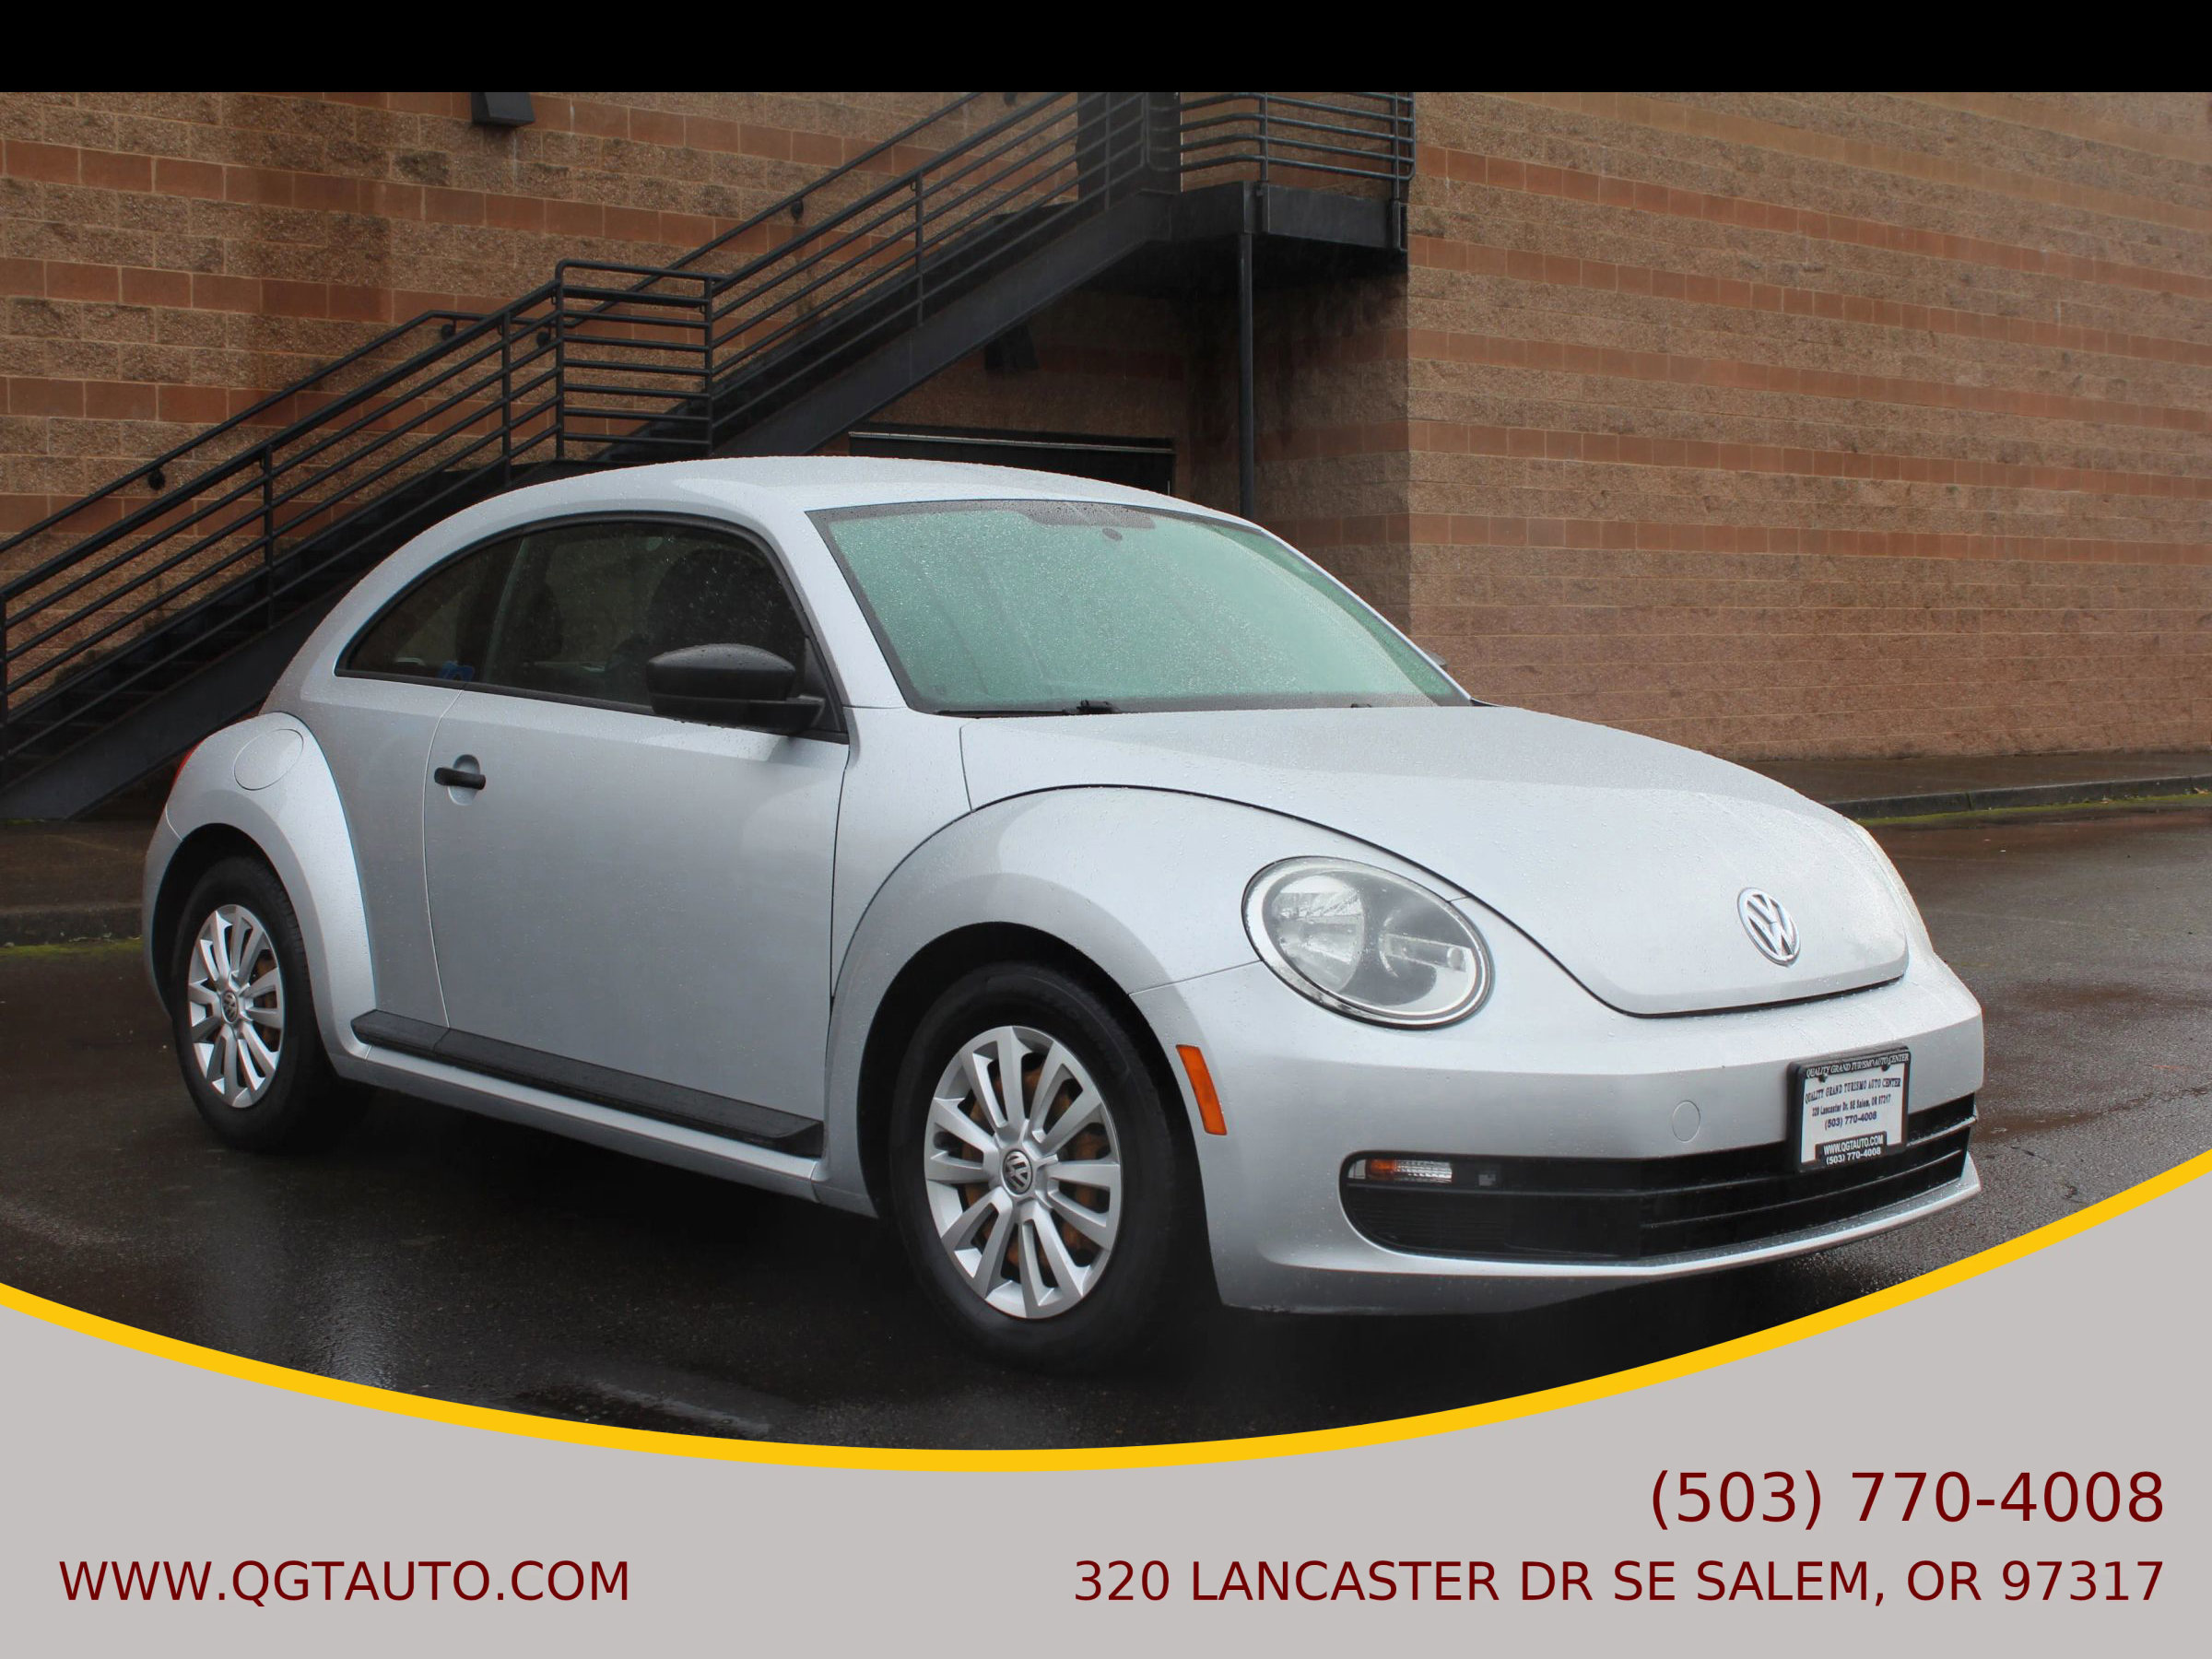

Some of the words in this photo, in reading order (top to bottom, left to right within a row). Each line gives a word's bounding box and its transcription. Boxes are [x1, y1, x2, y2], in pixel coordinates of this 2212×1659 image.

[1806, 1065, 1830, 1077] QUALITY
[1830, 1062, 1851, 1073] GRAND
[1873, 1056, 1888, 1067] AUTO
[1888, 1053, 1909, 1065] CENTER
[1805, 1088, 1824, 1104] QUALITY
[1826, 1084, 1842, 1098] GRAND
[1843, 1080, 1866, 1093] TURISMO
[1868, 1078, 1881, 1089] AUTO
[1883, 1077, 1900, 1088] CENTER
[1820, 1103, 1841, 1115] Lancaster
[1850, 1100, 1856, 1110] SE
[1872, 1096, 1877, 1106] OR
[1825, 1117, 1842, 1130] (503)
[1845, 1111, 1877, 1124] 770-4008
[1824, 1135, 1883, 1155] WWW.QGTAUTO.COM
[1826, 1154, 1845, 1166] (503)
[1847, 1147, 1881, 1160] 770-4008
